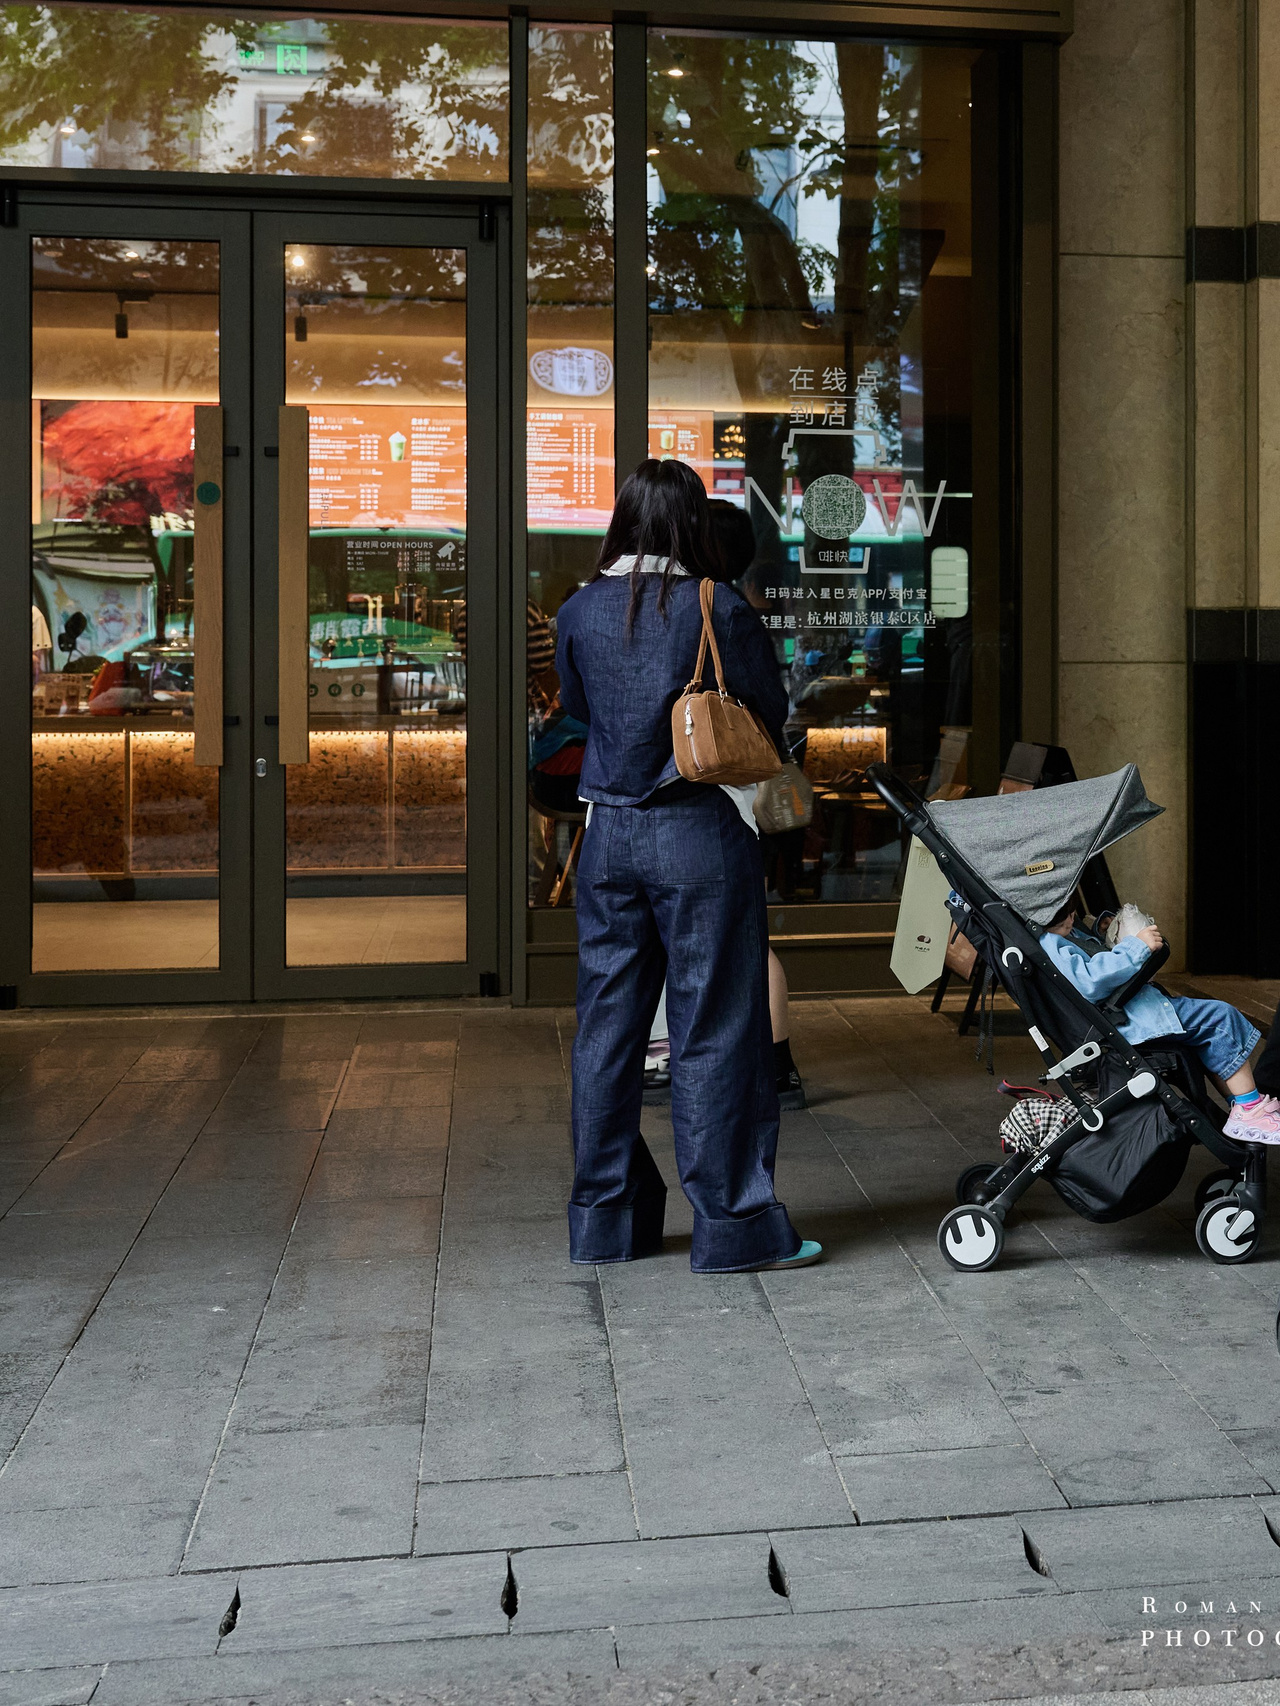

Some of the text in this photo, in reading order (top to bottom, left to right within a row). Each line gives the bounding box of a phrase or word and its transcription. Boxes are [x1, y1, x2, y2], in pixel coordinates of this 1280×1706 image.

[788, 366, 880, 394] 在线点
[788, 400, 880, 428] 到店取
[818, 550, 849, 562] 啡快
[806, 610, 936, 626] 杭州湖滨银泰C区店
[1030, 1154, 1051, 1174] squizz
